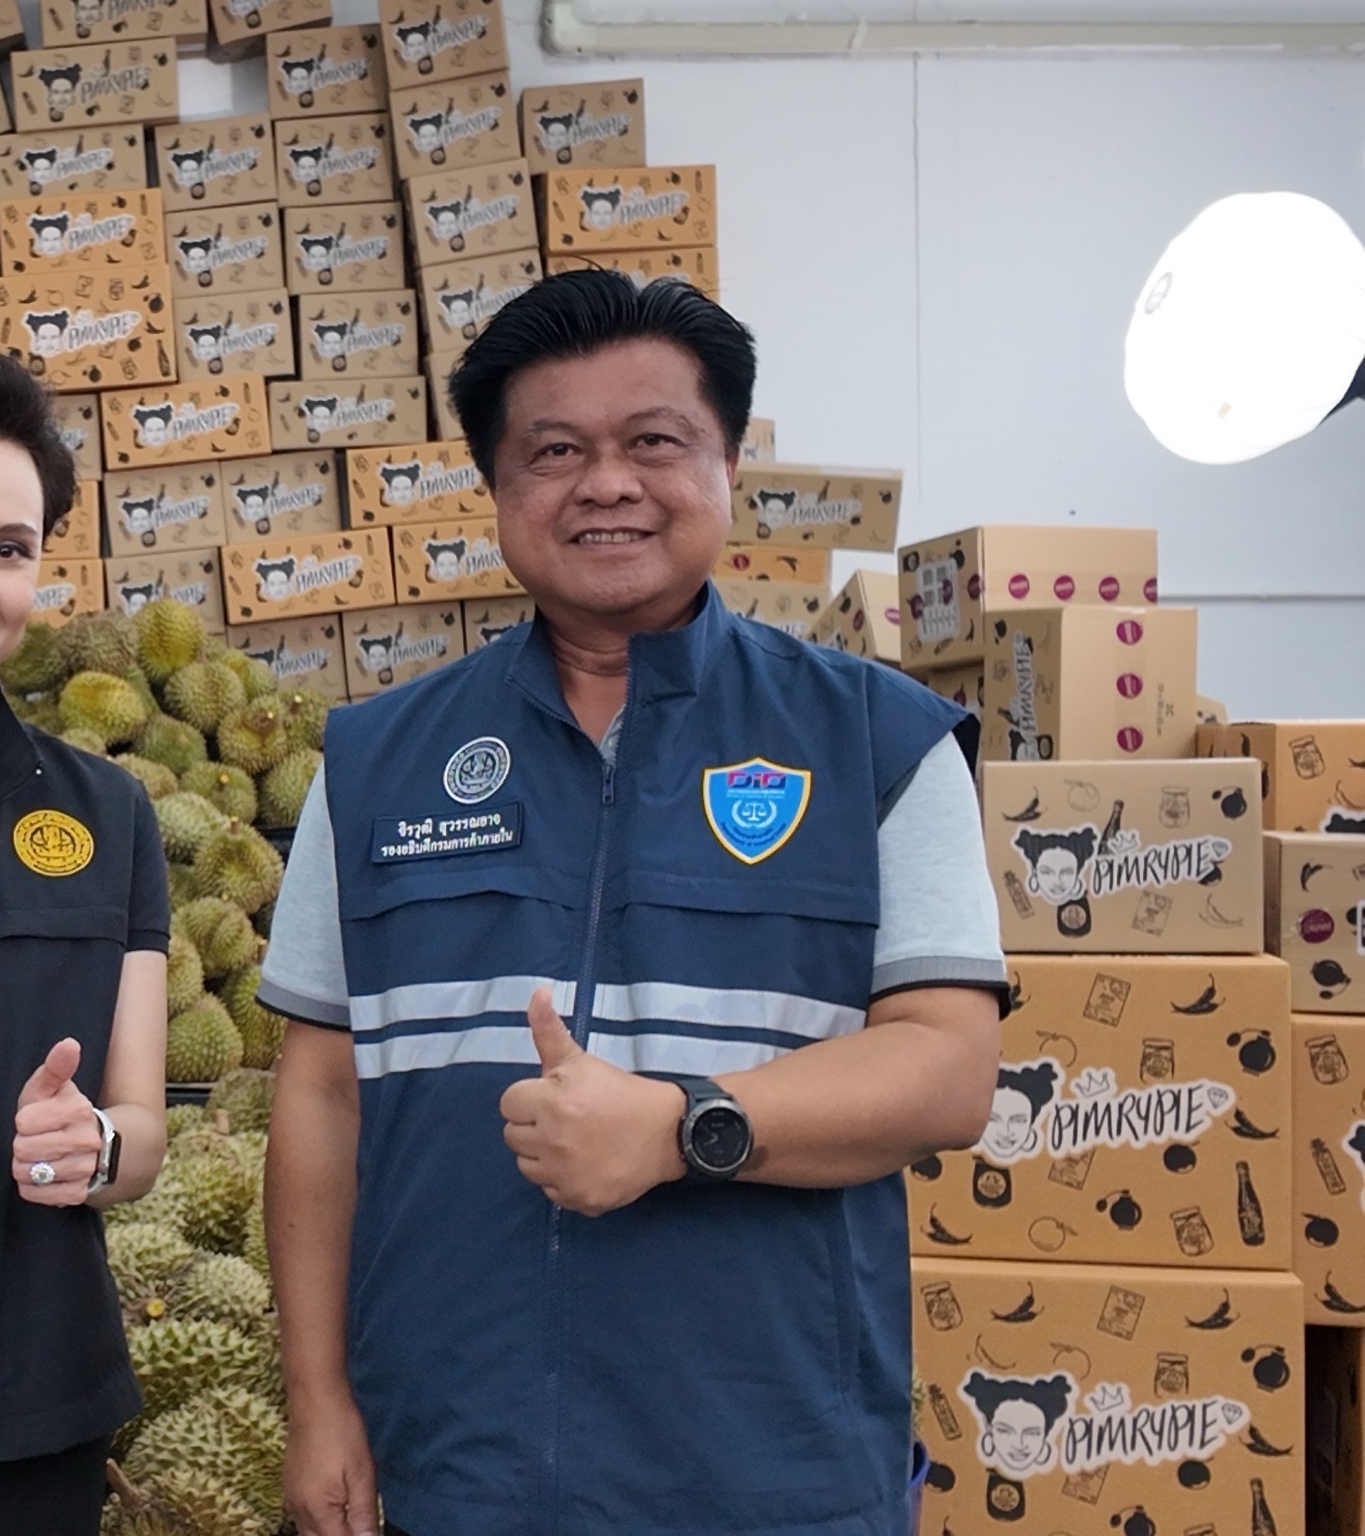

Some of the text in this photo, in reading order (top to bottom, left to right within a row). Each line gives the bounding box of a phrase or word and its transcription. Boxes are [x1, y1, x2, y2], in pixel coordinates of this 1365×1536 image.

[1092, 839, 1209, 894] PIMRYPIE
[1051, 1084, 1205, 1151] PIMRYPIE
[1062, 1399, 1219, 1466] PIMRYPIE
